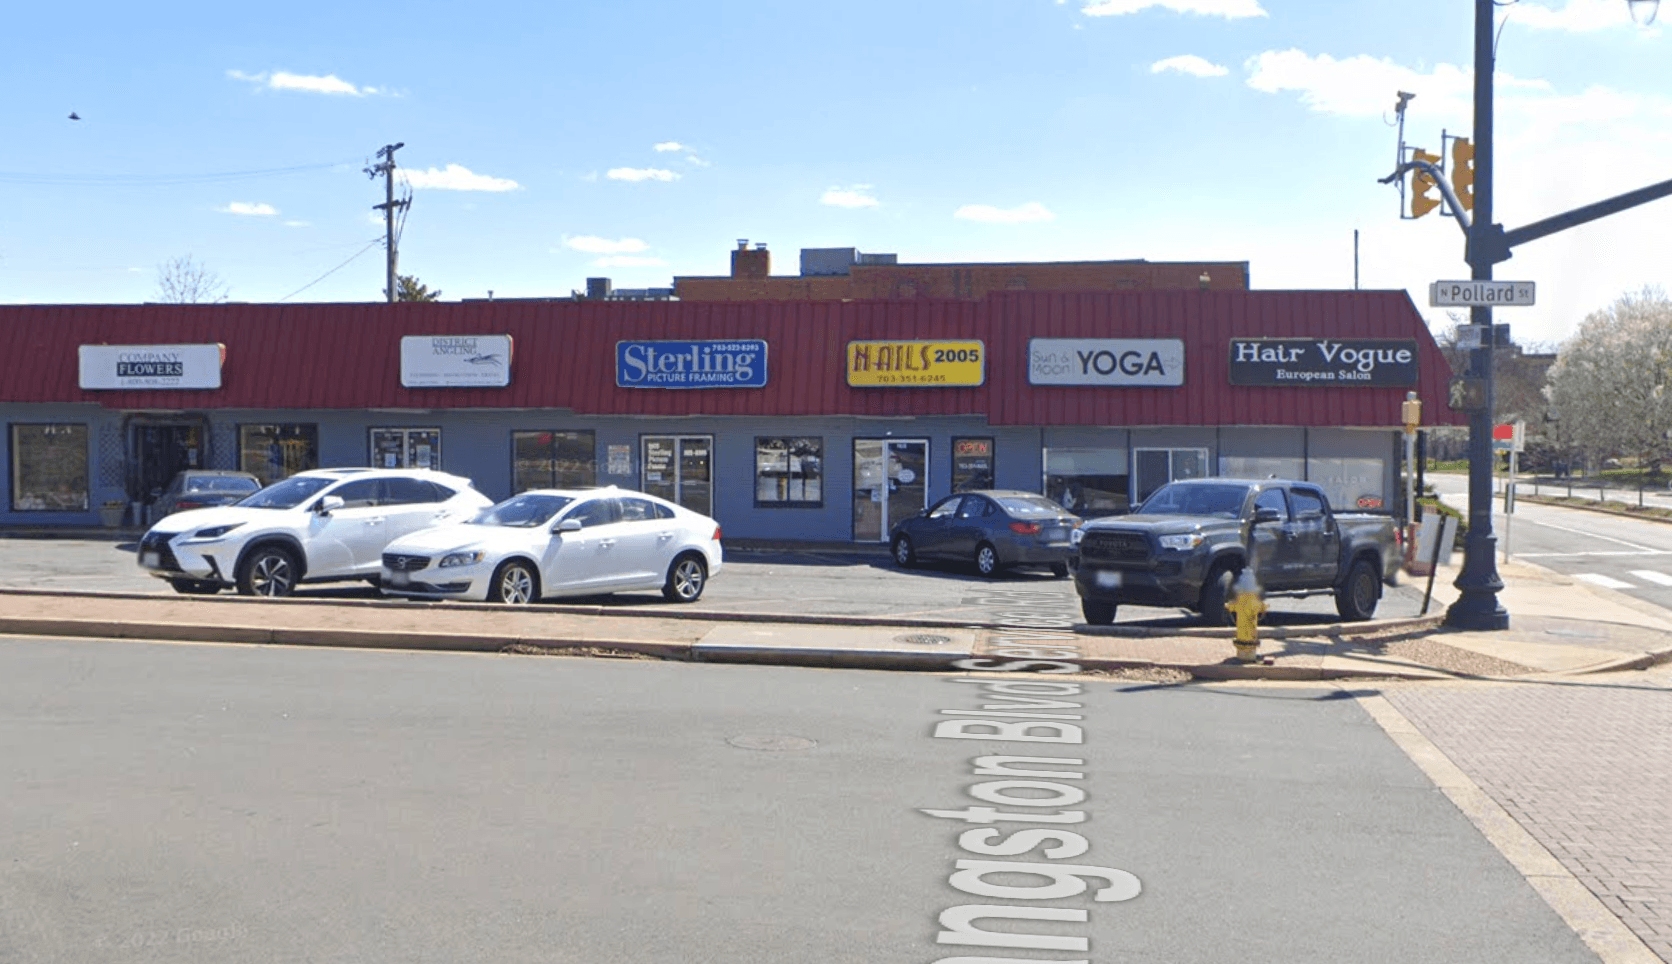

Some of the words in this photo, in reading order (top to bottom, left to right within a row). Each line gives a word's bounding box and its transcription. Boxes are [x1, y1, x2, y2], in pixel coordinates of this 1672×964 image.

[1441, 288, 1448, 297] N
[1451, 284, 1514, 301] Pollard
[1519, 289, 1529, 298] St
[432, 338, 478, 347] DISTRICT
[433, 347, 476, 355] ANGLING
[1032, 351, 1057, 363] Sun
[1236, 343, 1305, 362] Hair
[1316, 340, 1412, 372] Vogue
[119, 353, 179, 362] COMPANY
[624, 344, 756, 382] Sterling
[853, 344, 933, 372] NAILS
[934, 349, 979, 362] 2005
[1076, 350, 1165, 376] YOGA
[119, 363, 182, 375] FLOWERS
[1032, 364, 1070, 375] Moon
[1276, 369, 1335, 381] European
[1338, 370, 1371, 380] Salon
[647, 373, 687, 382] PICTURE
[689, 373, 734, 382] FRAMING
